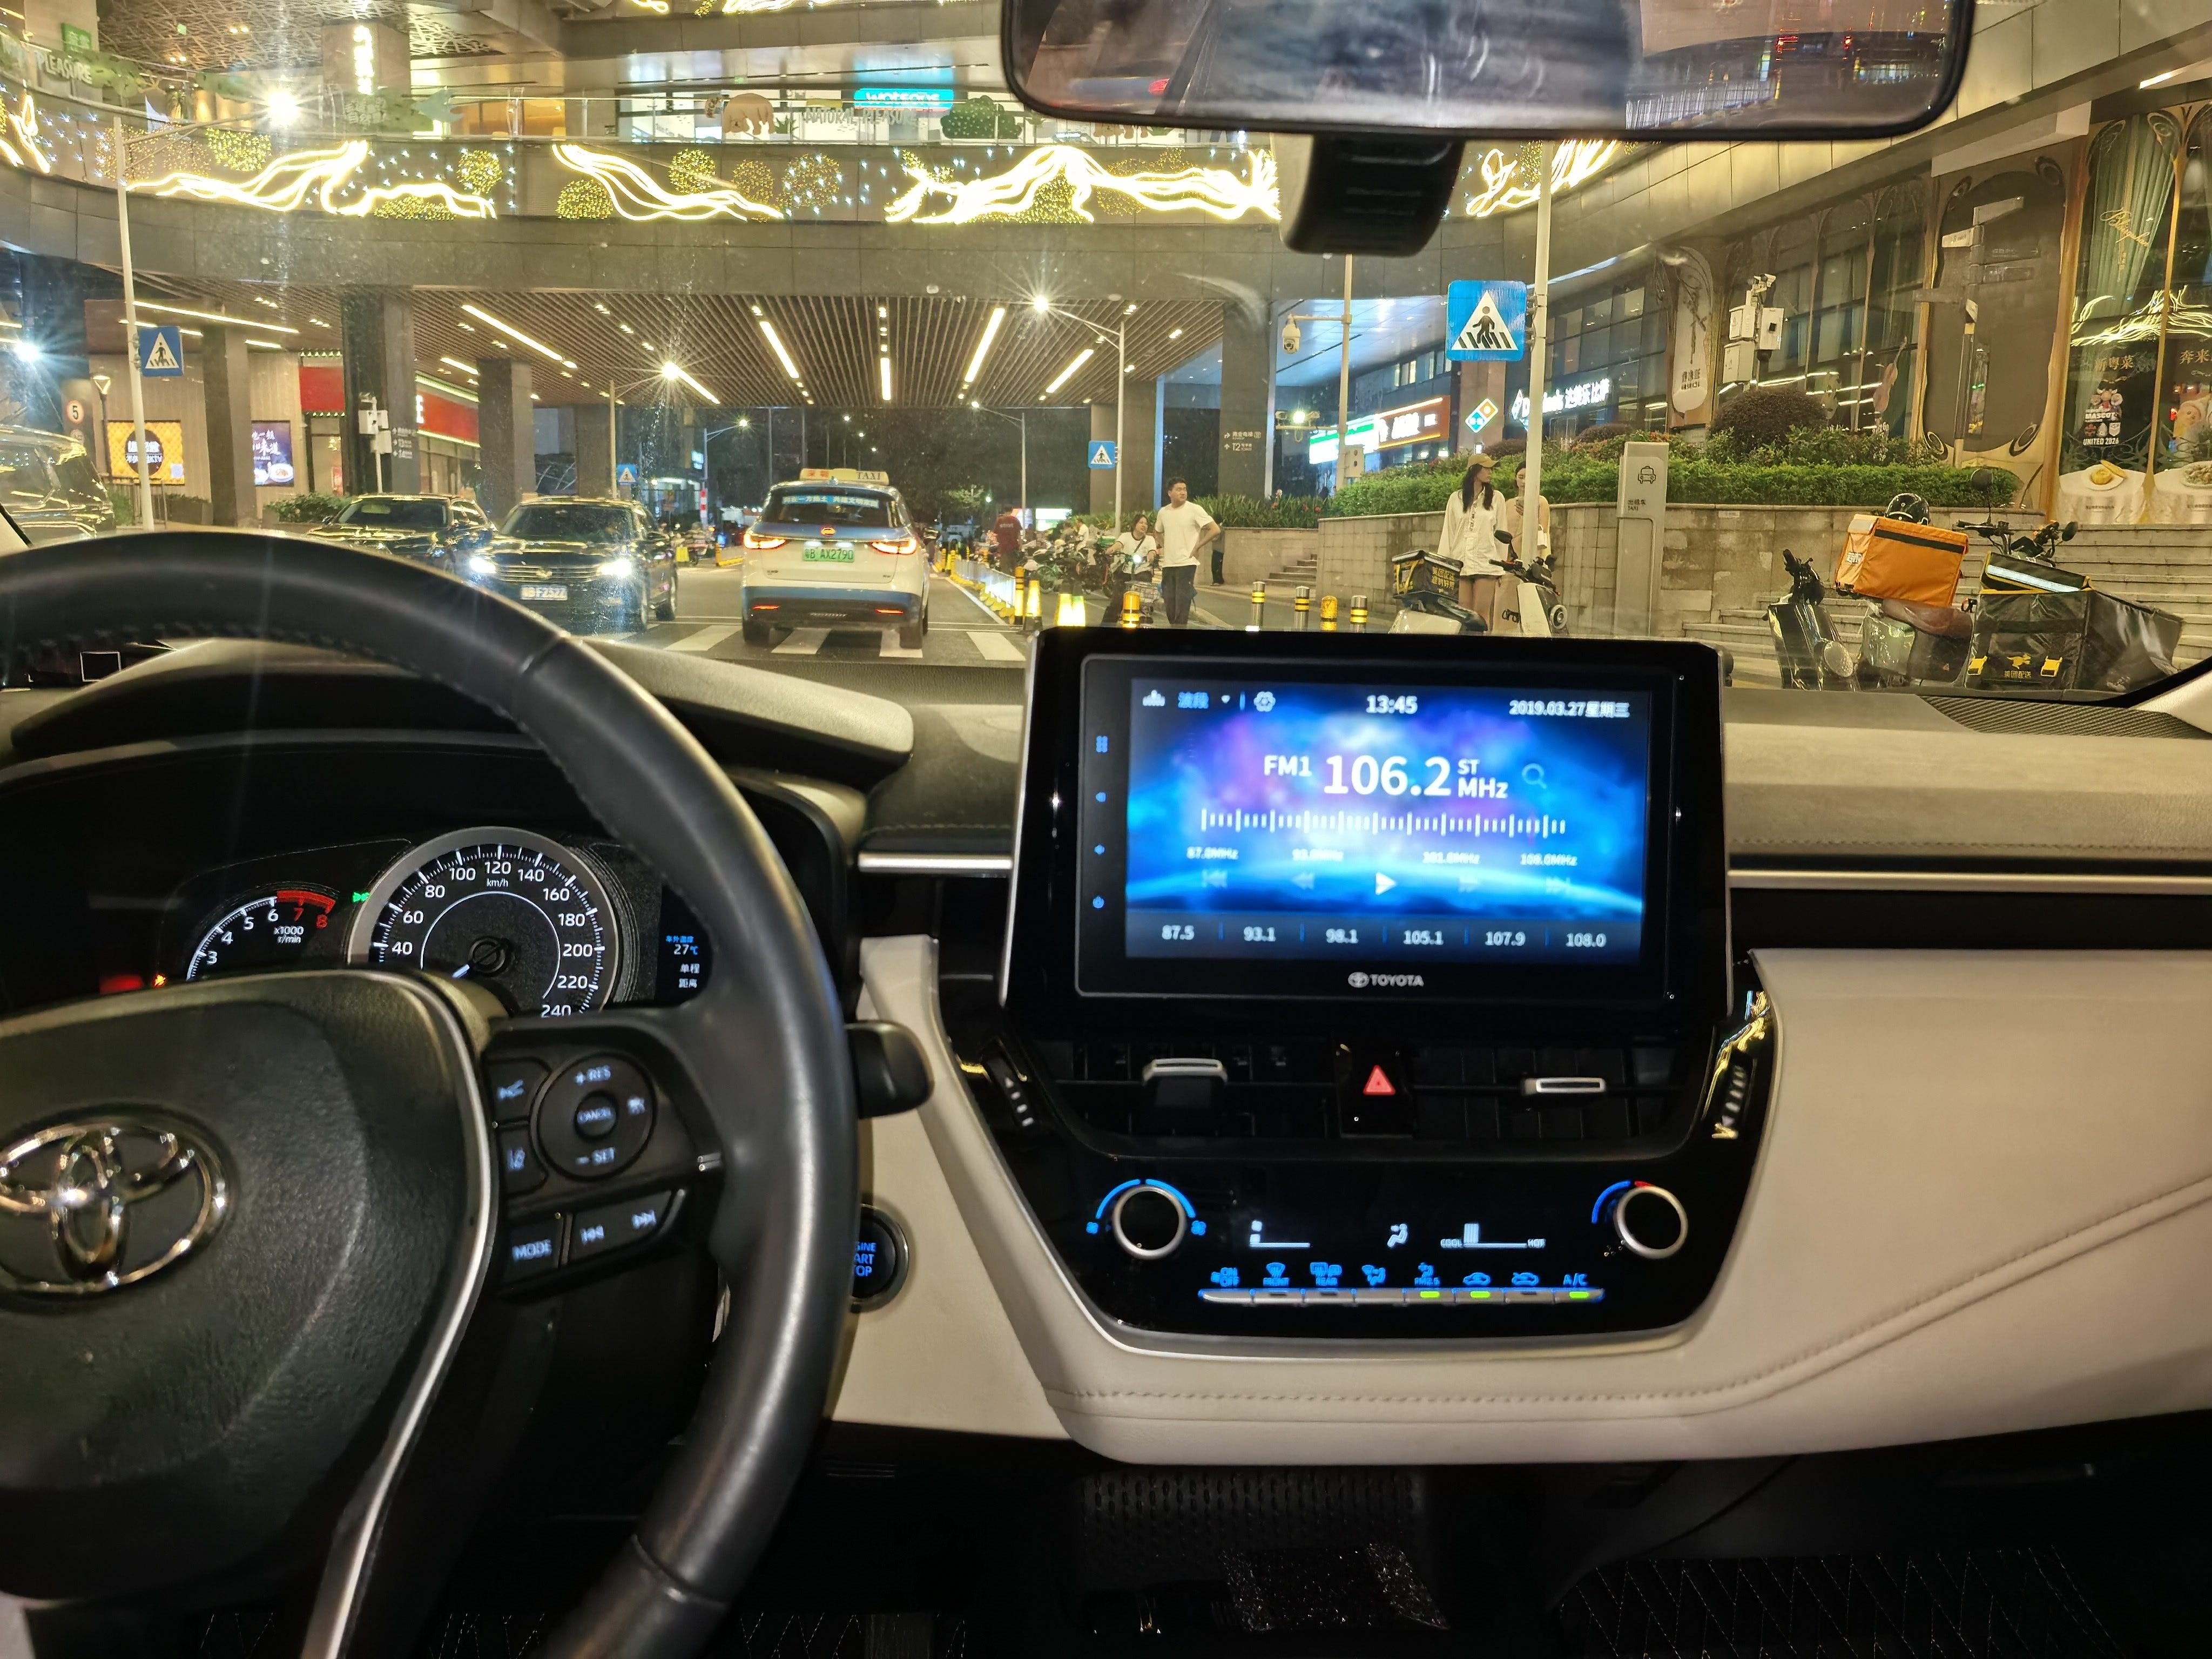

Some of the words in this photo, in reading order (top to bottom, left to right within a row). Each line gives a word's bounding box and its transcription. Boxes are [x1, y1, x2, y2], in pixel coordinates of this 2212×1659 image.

[805, 106, 854, 125] NATURAL
[2180, 348, 2212, 365] 奔来
[72, 405, 79, 420] 5
[857, 471, 881, 480] TAXI
[1366, 694, 1418, 714] 13:45
[1458, 758, 1480, 775] ST
[1264, 754, 1312, 777] FM1
[1324, 754, 1452, 796] 106.2
[1458, 777, 1509, 799] MHz
[449, 867, 476, 881] 100
[484, 861, 511, 875] 120
[517, 868, 545, 882] 140
[487, 878, 509, 888] km/h
[424, 885, 446, 899] 80
[543, 888, 570, 901] 160
[267, 908, 279, 922] 6
[293, 907, 305, 922] 7
[316, 914, 328, 928] 8
[402, 911, 424, 924] 60
[558, 913, 585, 927] 180
[243, 917, 254, 930] 5
[273, 926, 304, 936] x1000
[1161, 925, 1195, 941] 87.5
[1243, 926, 1276, 942] 93.1
[1325, 928, 1359, 944] 98.1
[1403, 929, 1444, 946] 105.1
[1485, 930, 1526, 947] 107.9
[1566, 932, 1607, 948] 108.0
[221, 932, 233, 945] 4
[277, 935, 301, 944] r/min
[392, 941, 413, 955] 40
[563, 943, 593, 957] 200
[206, 951, 217, 965] 3
[557, 975, 588, 989] 220
[1370, 974, 1425, 987] TOYOTA
[541, 1004, 571, 1018] 240
[512, 1239, 552, 1262] MODE
[1563, 1273, 1589, 1286] A/C
